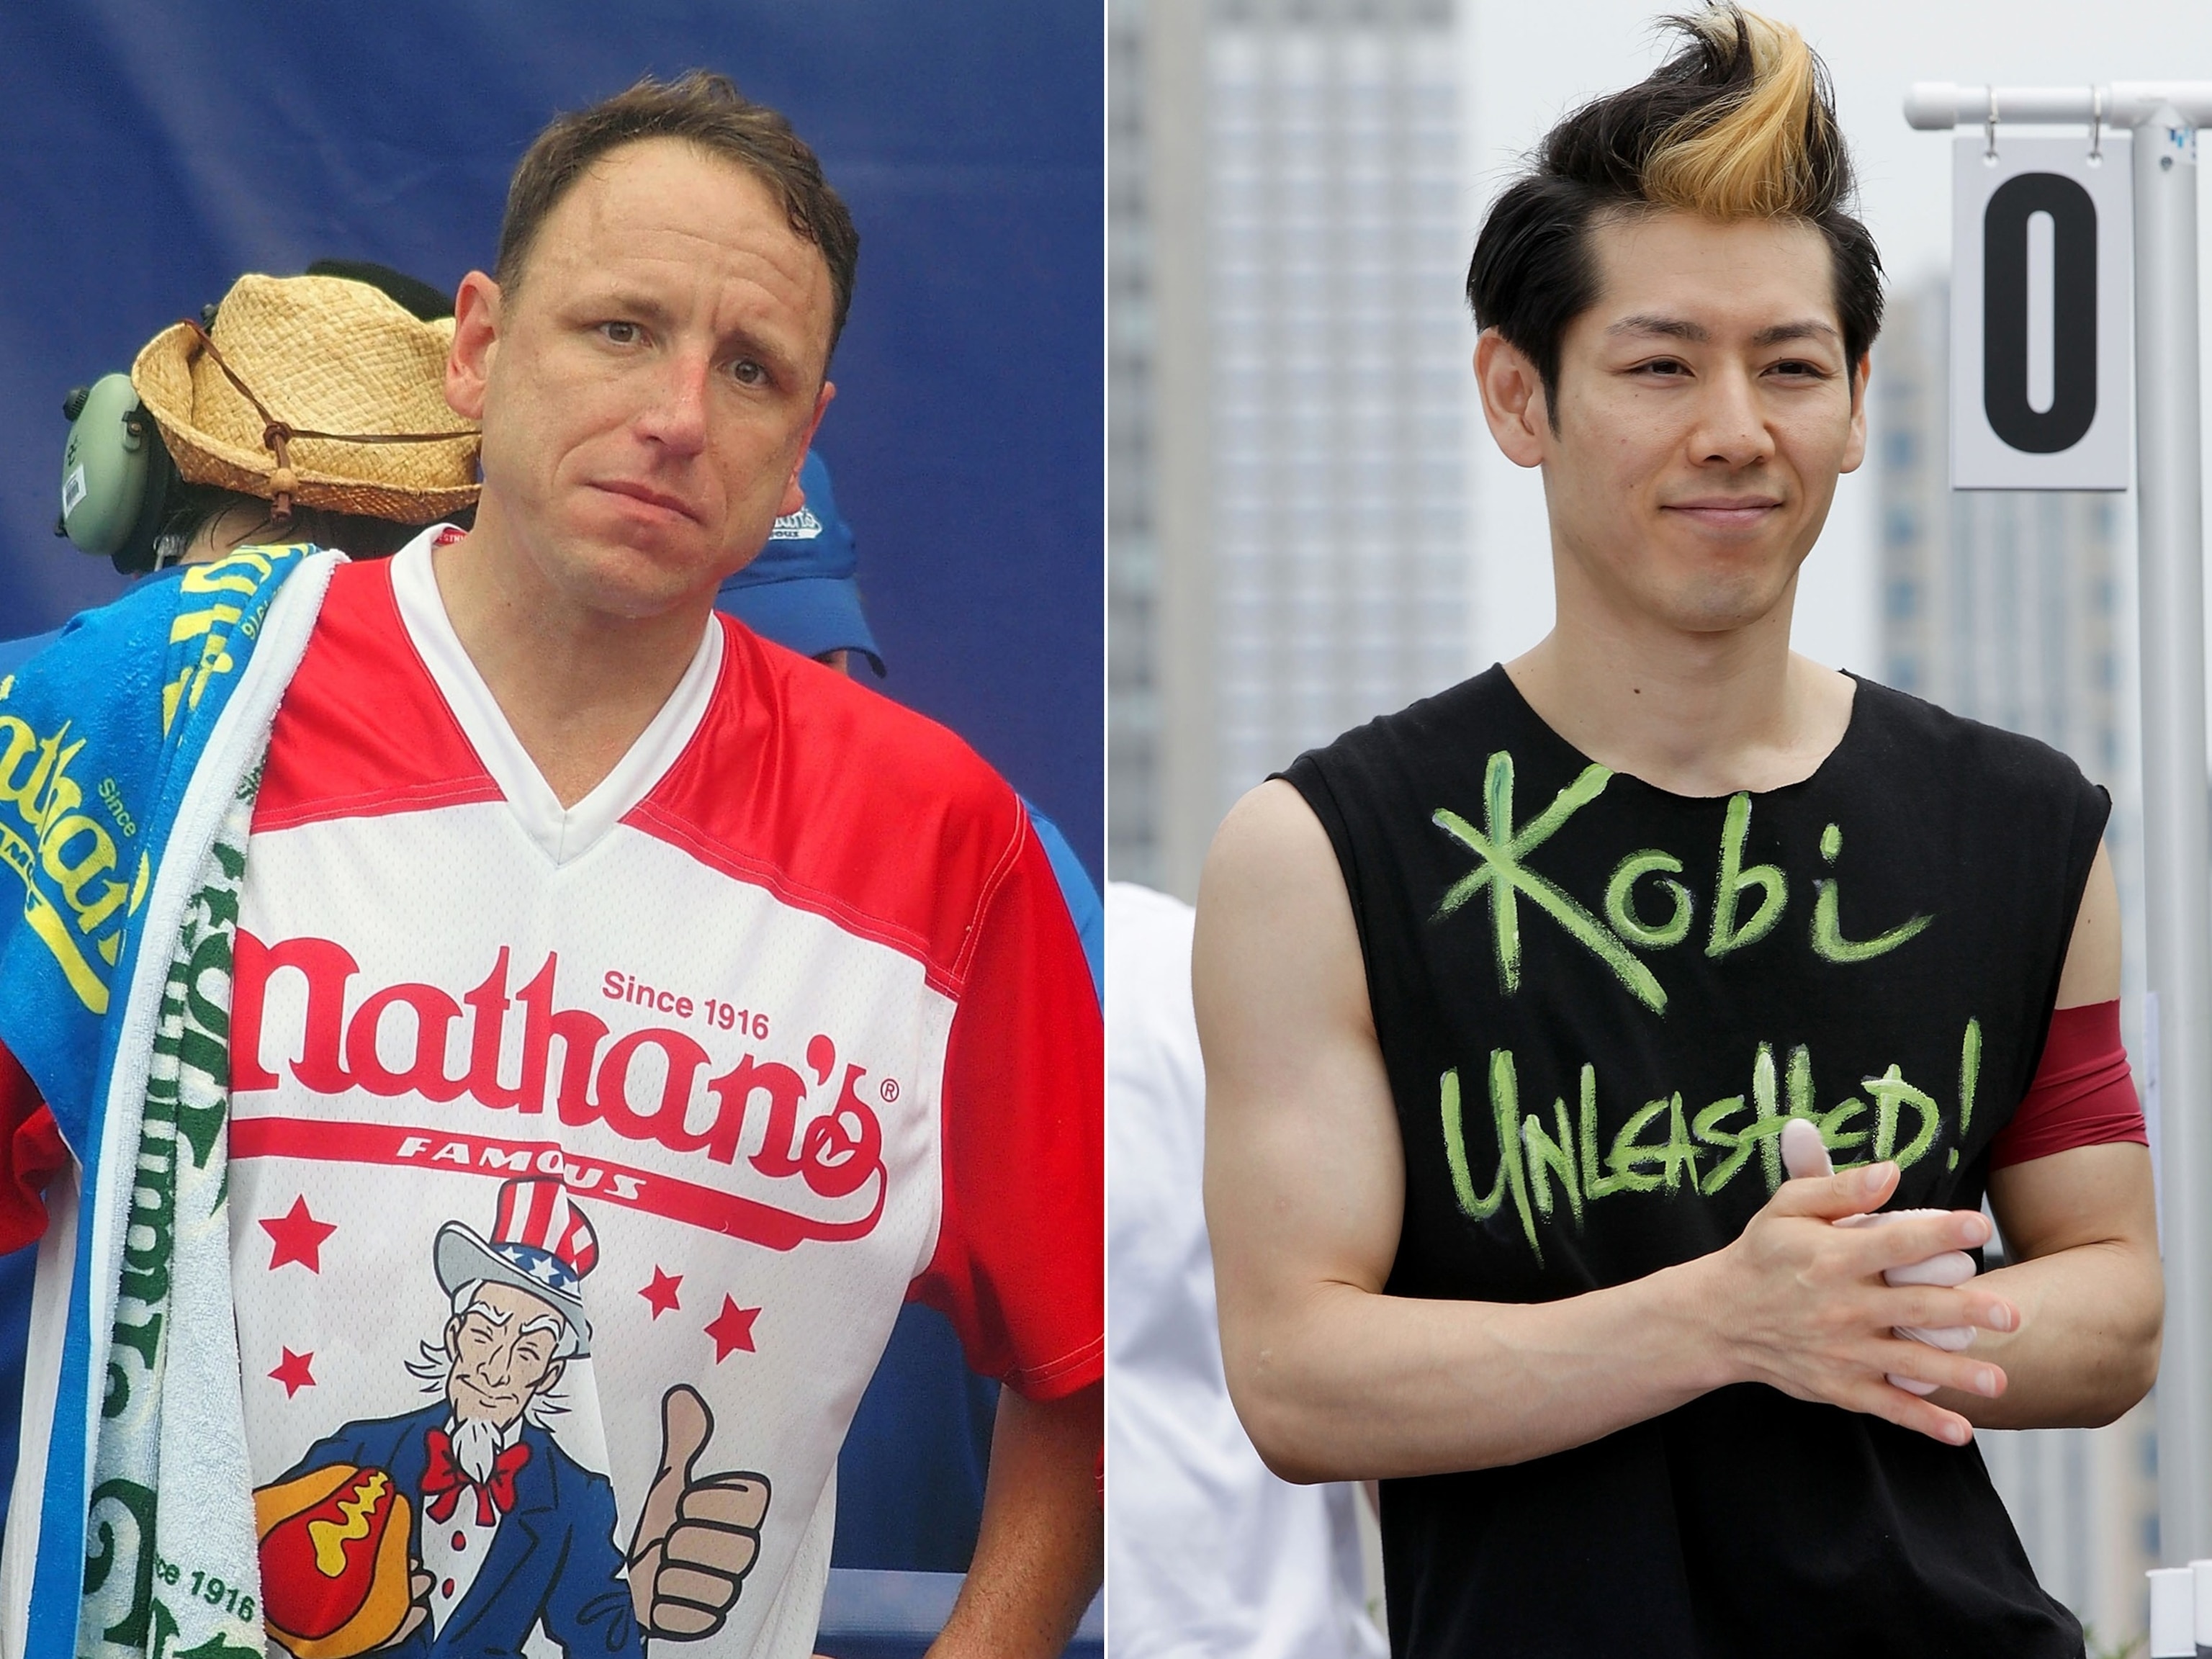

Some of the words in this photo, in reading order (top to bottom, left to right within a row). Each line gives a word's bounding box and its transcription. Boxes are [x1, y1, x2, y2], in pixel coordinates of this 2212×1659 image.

[1984, 172, 2096, 454] 0
[98, 777, 137, 837] Since
[1430, 750, 1937, 1017] Kobi
[602, 971, 693, 1018] Since
[704, 999, 770, 1040] 1916
[397, 1136, 647, 1200] FAMOUS
[1440, 1017, 1983, 1272] UNLEASHED!
[191, 1570, 256, 1623] 1916
